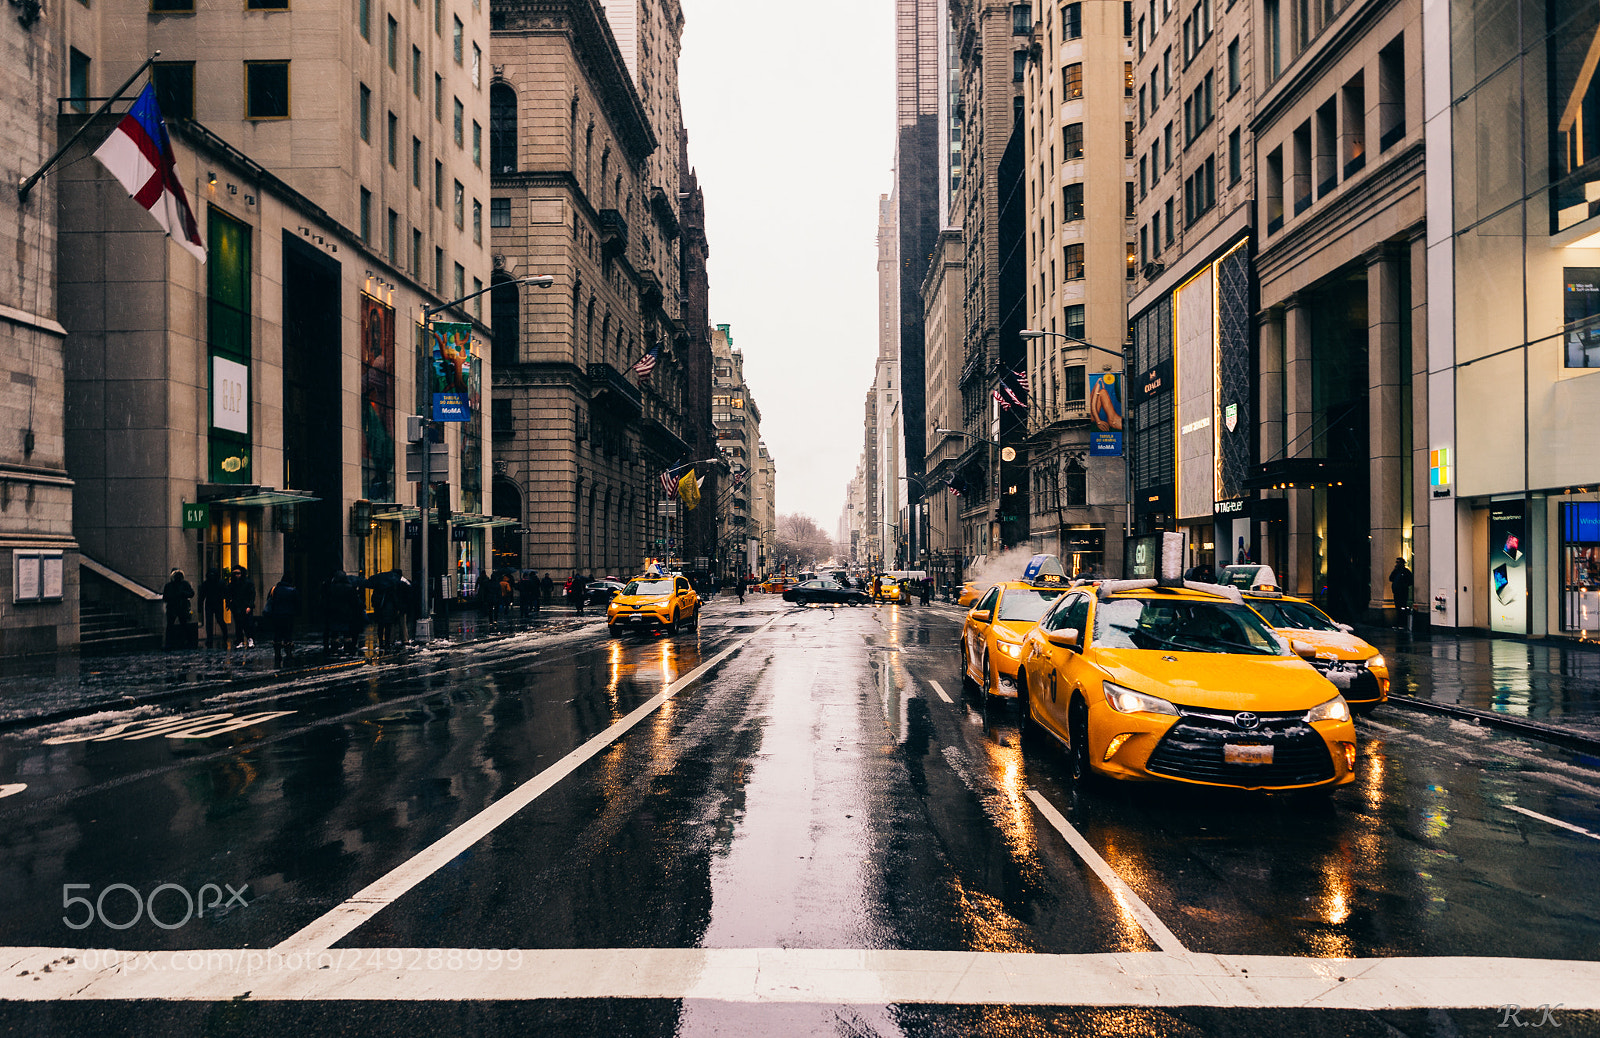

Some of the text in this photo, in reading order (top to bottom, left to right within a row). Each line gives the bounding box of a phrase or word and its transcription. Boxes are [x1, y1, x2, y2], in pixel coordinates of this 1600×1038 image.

[222, 378, 242, 413] GAP
[187, 509, 204, 522] GAP
[1135, 544, 1146, 564] GO
